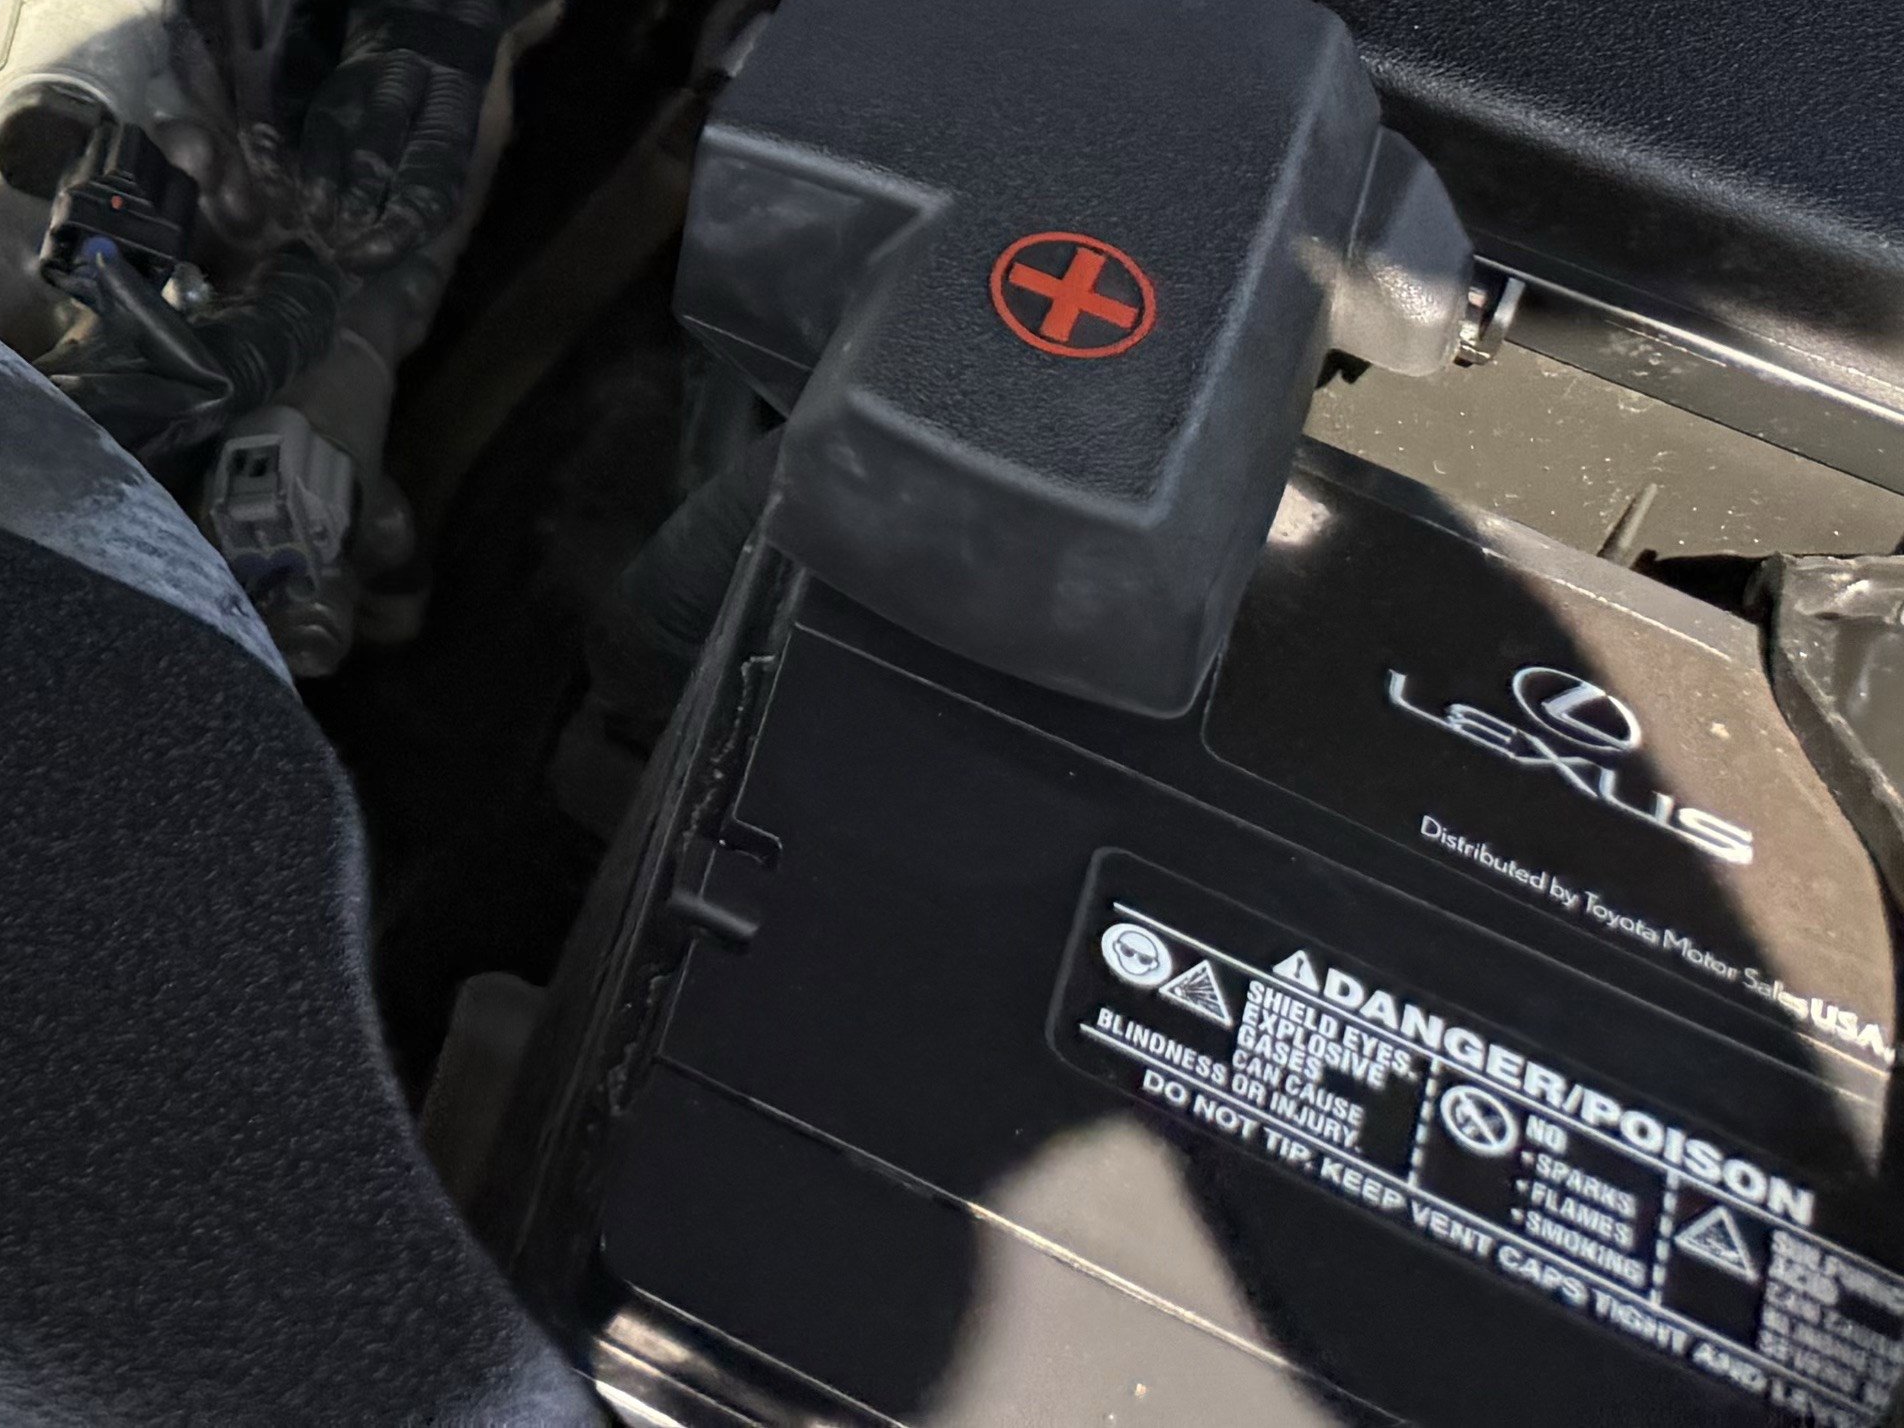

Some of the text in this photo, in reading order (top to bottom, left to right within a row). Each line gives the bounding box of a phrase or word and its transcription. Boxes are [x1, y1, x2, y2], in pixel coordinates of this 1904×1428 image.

[1388, 668, 1754, 866] LEXUS
[1420, 813, 1547, 892] Distributed
[1549, 875, 1579, 908] by
[1584, 890, 1661, 945] Toyota
[1662, 928, 1739, 982] Motor
[1743, 966, 1809, 1022] Sales
[1236, 1026, 1324, 1083] GASES
[1242, 1002, 1387, 1090] EXPLOSIVE
[1246, 980, 1419, 1081] SHIELD EYES.
[1096, 1006, 1362, 1153] BLINDNESS OR INJURY.
[1232, 1049, 1365, 1128] CAN CAUSE
[1323, 967, 1815, 1227] DANGER/POISON
[1524, 1113, 1569, 1156] NO
[1142, 1068, 1188, 1109] DO
[1192, 1093, 1261, 1141] NOT
[1263, 1125, 1314, 1170] TIP.
[1319, 1157, 1408, 1211] KEEP
[1411, 1198, 1495, 1259] VENT
[1497, 1244, 1589, 1309] CAPS
[1530, 1180, 1635, 1251] FLAMES
[1535, 1152, 1638, 1219] SPARKS
[1524, 1209, 1647, 1290] SMOKING
